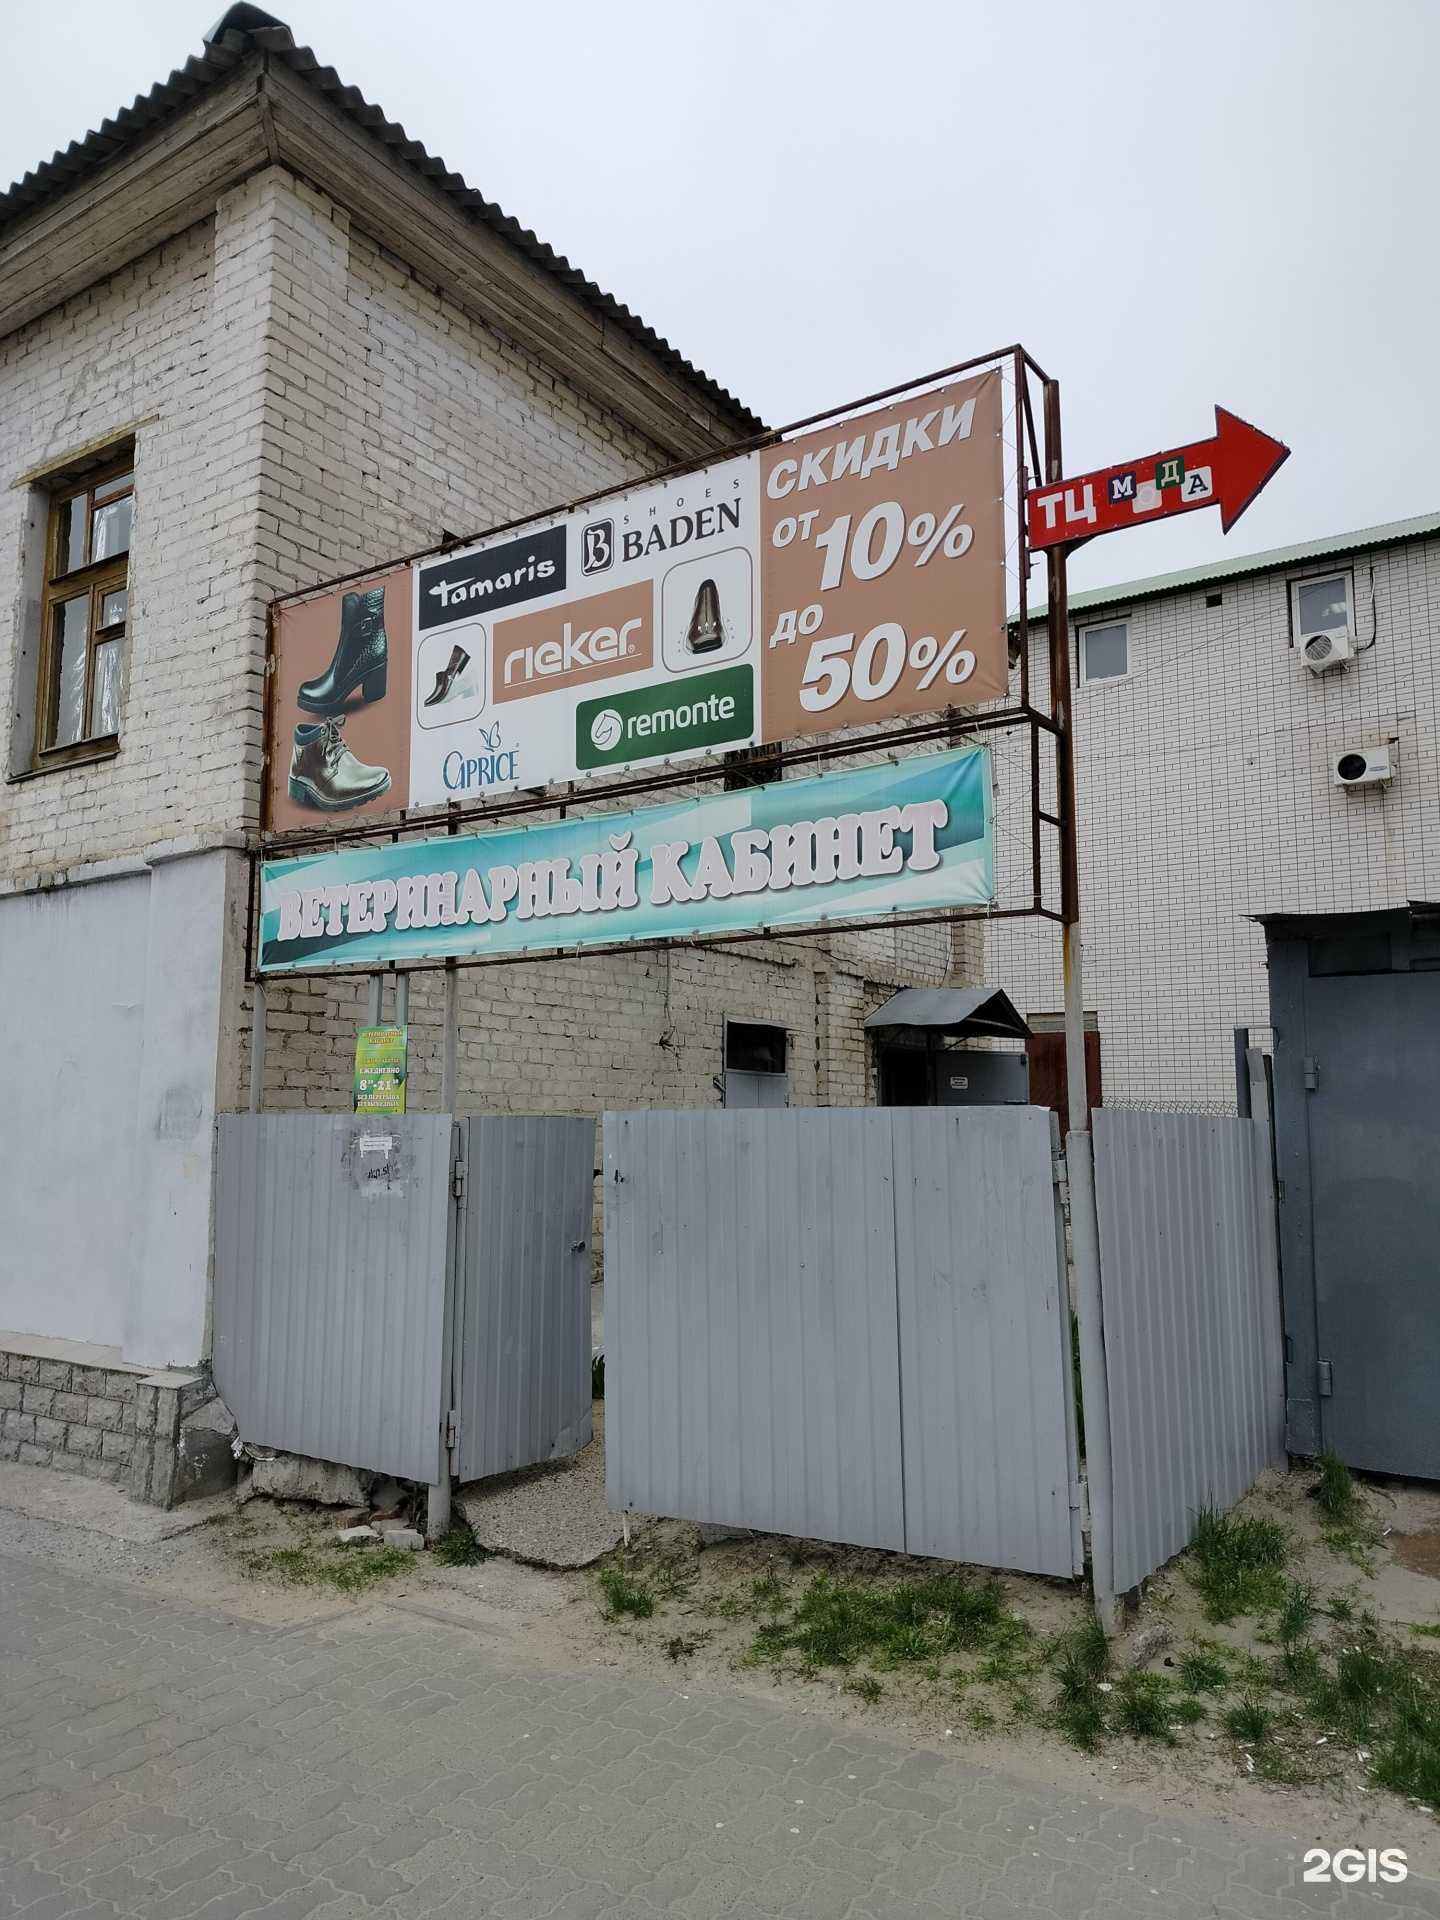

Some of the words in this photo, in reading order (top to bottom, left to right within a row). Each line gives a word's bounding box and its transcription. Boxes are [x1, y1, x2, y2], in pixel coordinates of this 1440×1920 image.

[766, 398, 977, 500] СКИДКИ
[622, 497, 742, 563] BADEN
[623, 478, 740, 525] SHOES
[1036, 487, 1098, 529] ТЦ
[814, 500, 975, 592] 10%
[428, 554, 556, 608] Tamaris
[504, 617, 643, 685] rieker
[799, 622, 977, 713] 50%
[627, 694, 736, 739] remonte
[276, 830, 640, 943] ВЕТЕРИНАРНЫЙ
[649, 799, 949, 905] КАБИНЕТ
